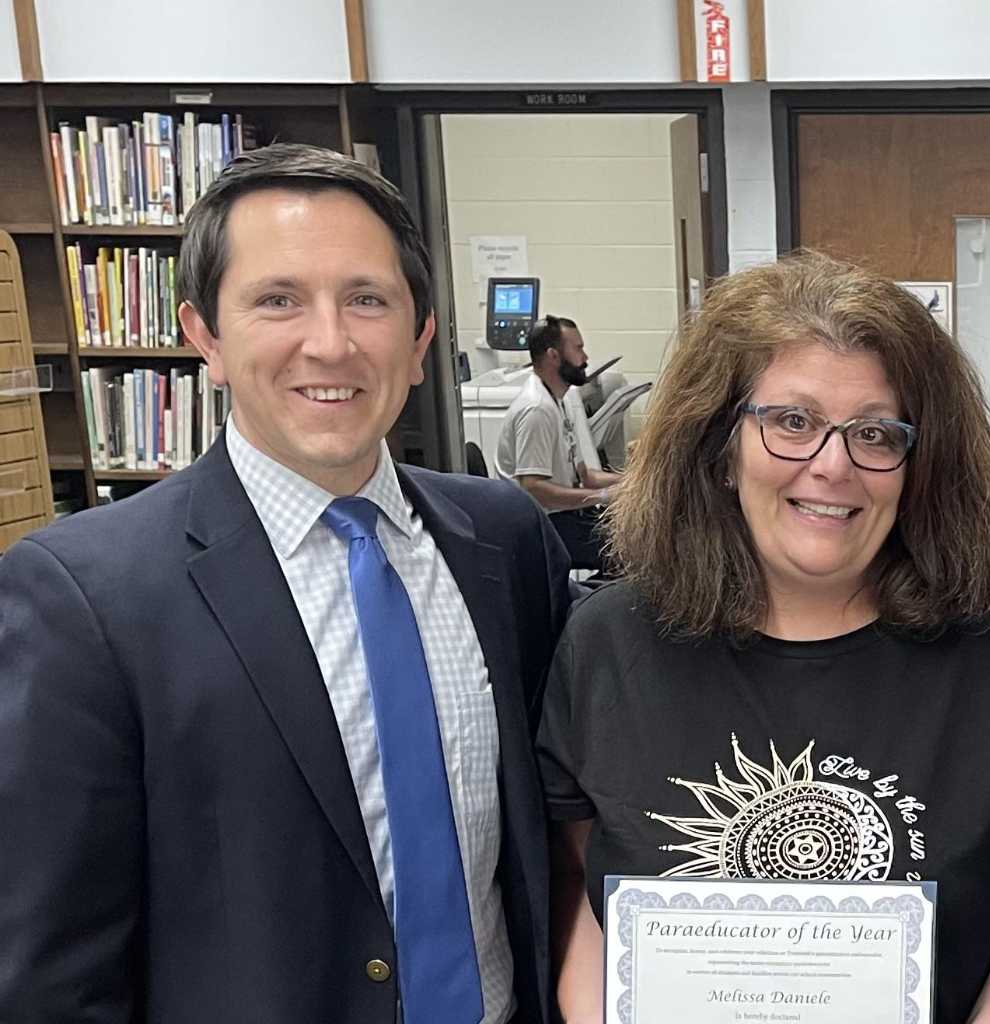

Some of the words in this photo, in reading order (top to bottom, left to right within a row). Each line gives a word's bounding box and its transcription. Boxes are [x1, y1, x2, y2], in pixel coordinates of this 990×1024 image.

[711, 19, 727, 77] FIRE
[526, 93, 553, 105] WORK
[557, 93, 587, 105] ROOM
[818, 754, 871, 781] Live
[872, 773, 900, 799] by
[894, 794, 927, 825] the
[907, 828, 926, 861] sun
[646, 919, 782, 939] Paraeducator
[787, 920, 809, 945] of
[812, 922, 842, 940] the
[851, 924, 897, 944] Year
[706, 988, 765, 1004] Melissa
[770, 989, 832, 1005] Daniele
